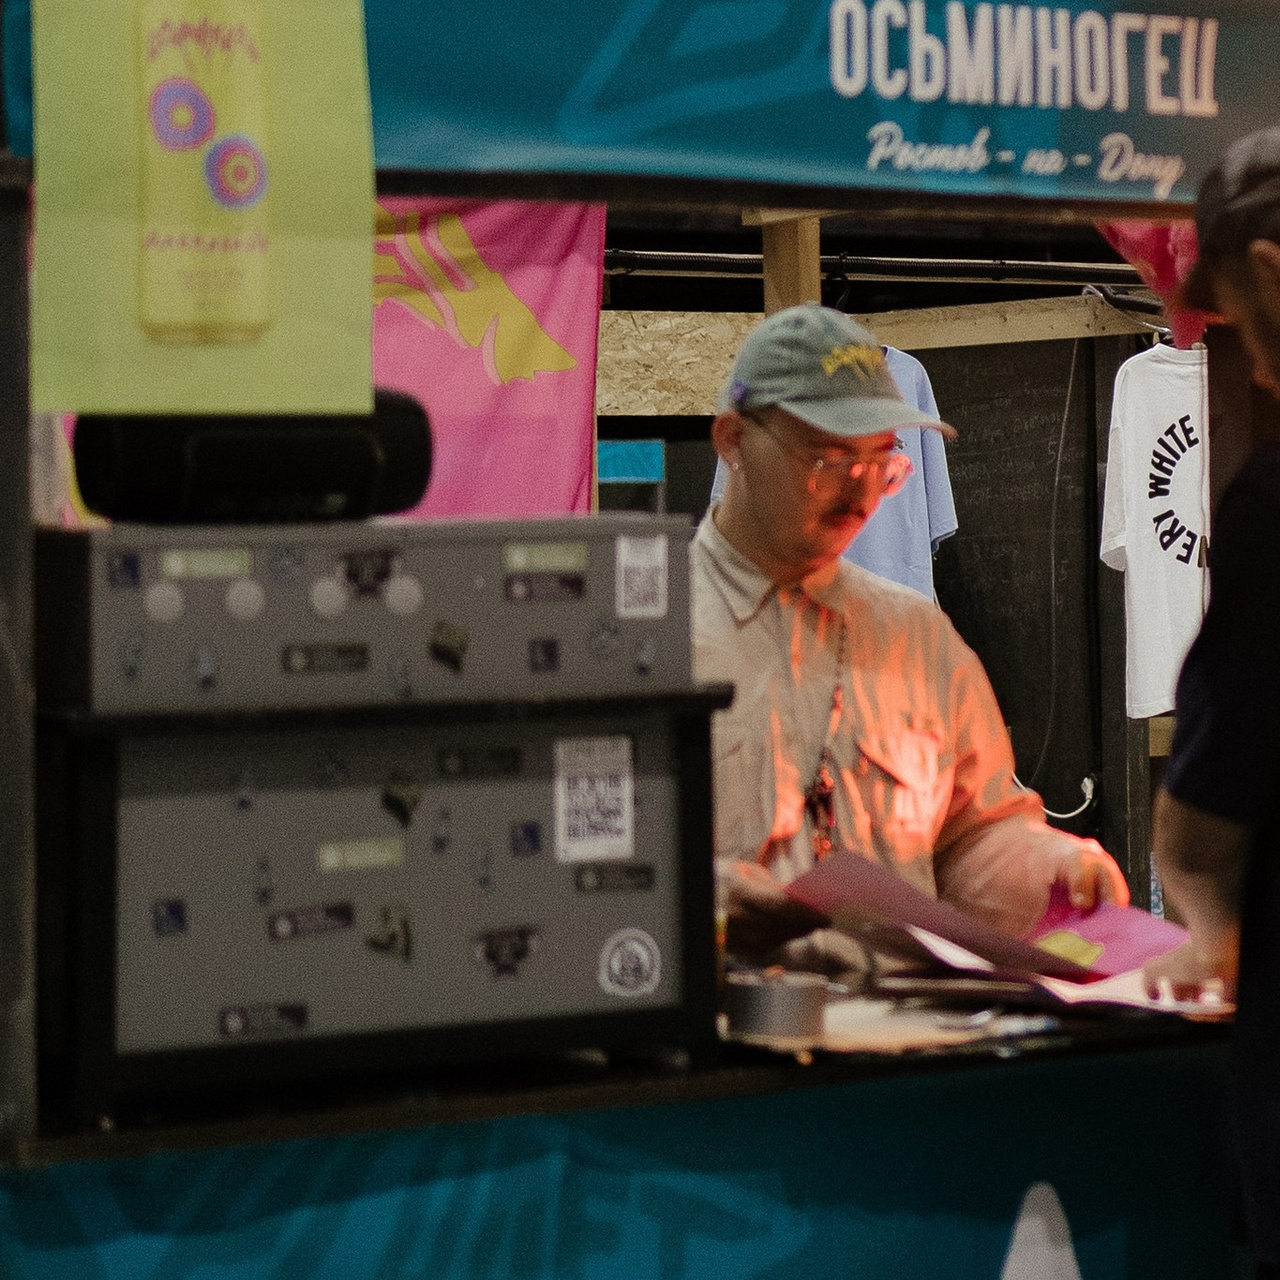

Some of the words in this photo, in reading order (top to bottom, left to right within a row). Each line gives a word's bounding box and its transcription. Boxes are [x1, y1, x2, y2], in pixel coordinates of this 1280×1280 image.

[866, 120, 991, 172] Ростов
[1022, 149, 1068, 175] на
[1148, 414, 1200, 500] WHITE
